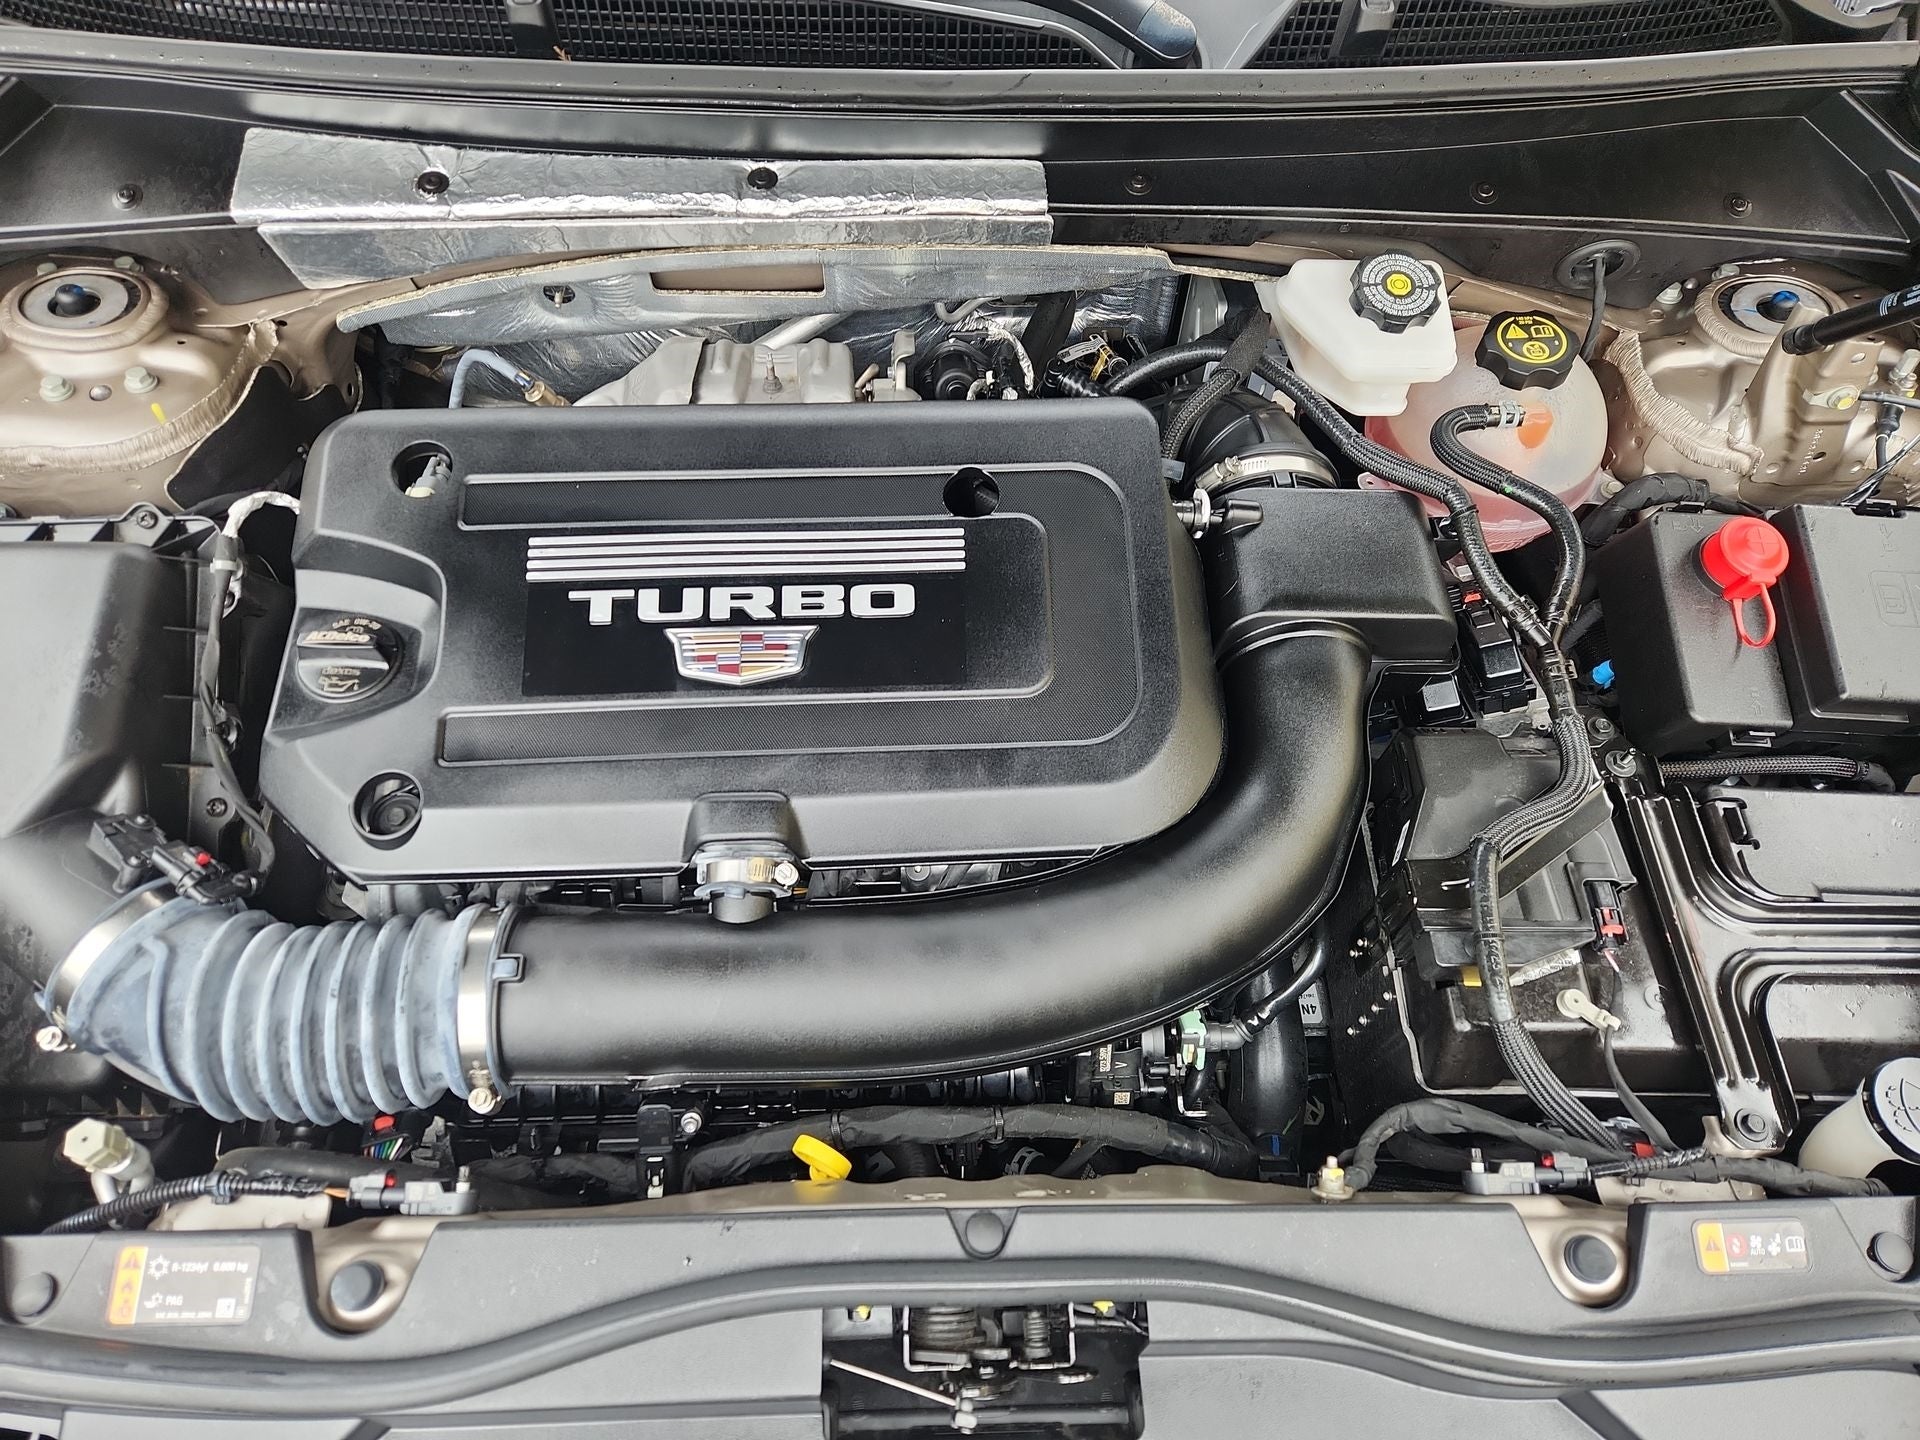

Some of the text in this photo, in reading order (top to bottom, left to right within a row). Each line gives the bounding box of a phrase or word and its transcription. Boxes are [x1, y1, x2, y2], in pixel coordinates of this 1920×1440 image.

[568, 583, 915, 625] TURBO
[304, 630, 371, 643] ACDelco
[321, 665, 361, 676] dexos
[1750, 1247, 1766, 1257] AUTO
[165, 1295, 184, 1306] PAG
